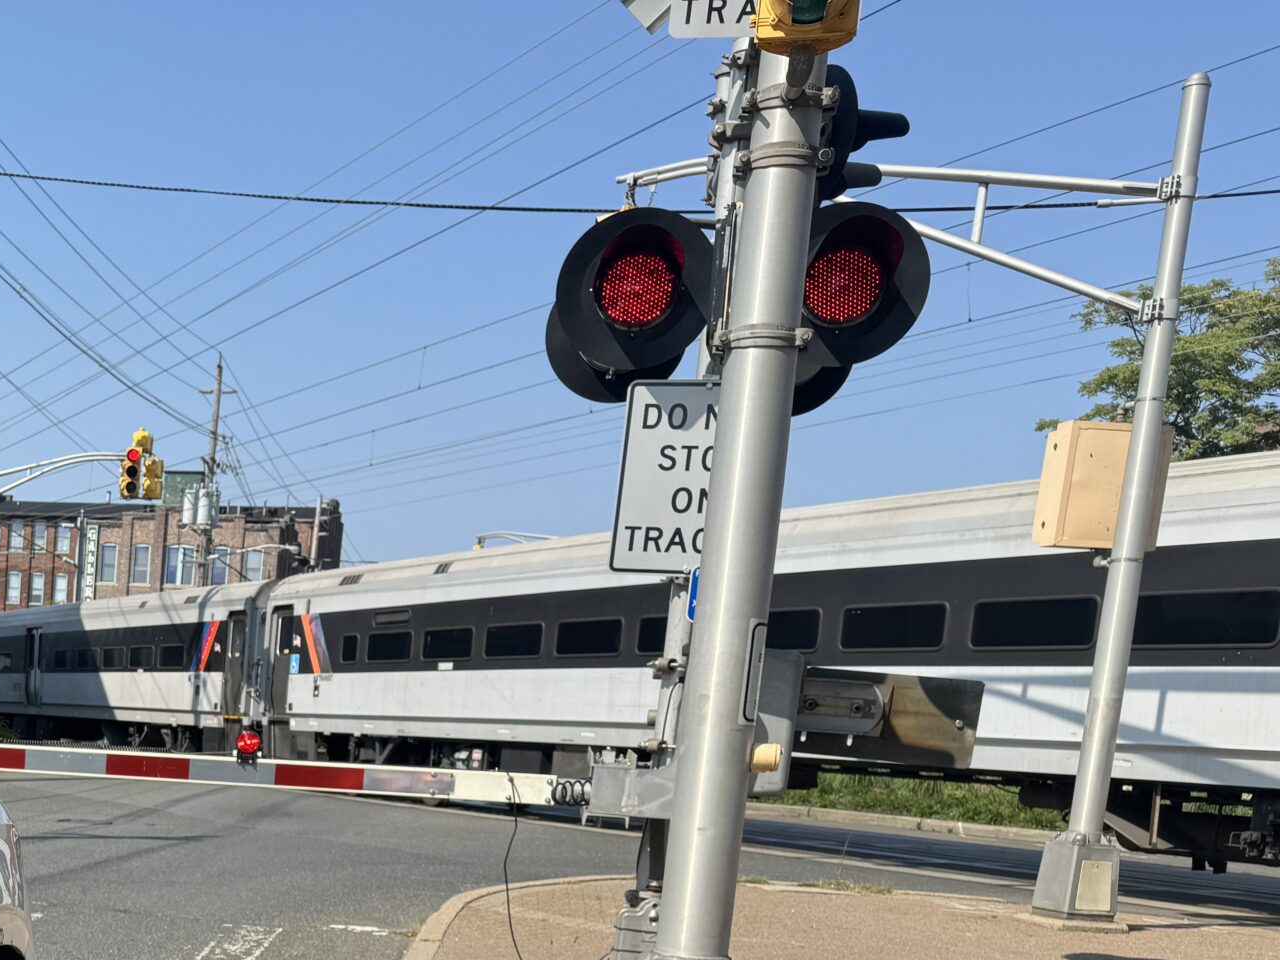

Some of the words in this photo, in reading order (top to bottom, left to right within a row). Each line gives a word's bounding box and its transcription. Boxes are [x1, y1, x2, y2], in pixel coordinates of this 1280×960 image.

[681, 0, 757, 25] TRA
[642, 403, 688, 430] DO
[658, 445, 715, 472] STO
[624, 526, 704, 554] TRAC
